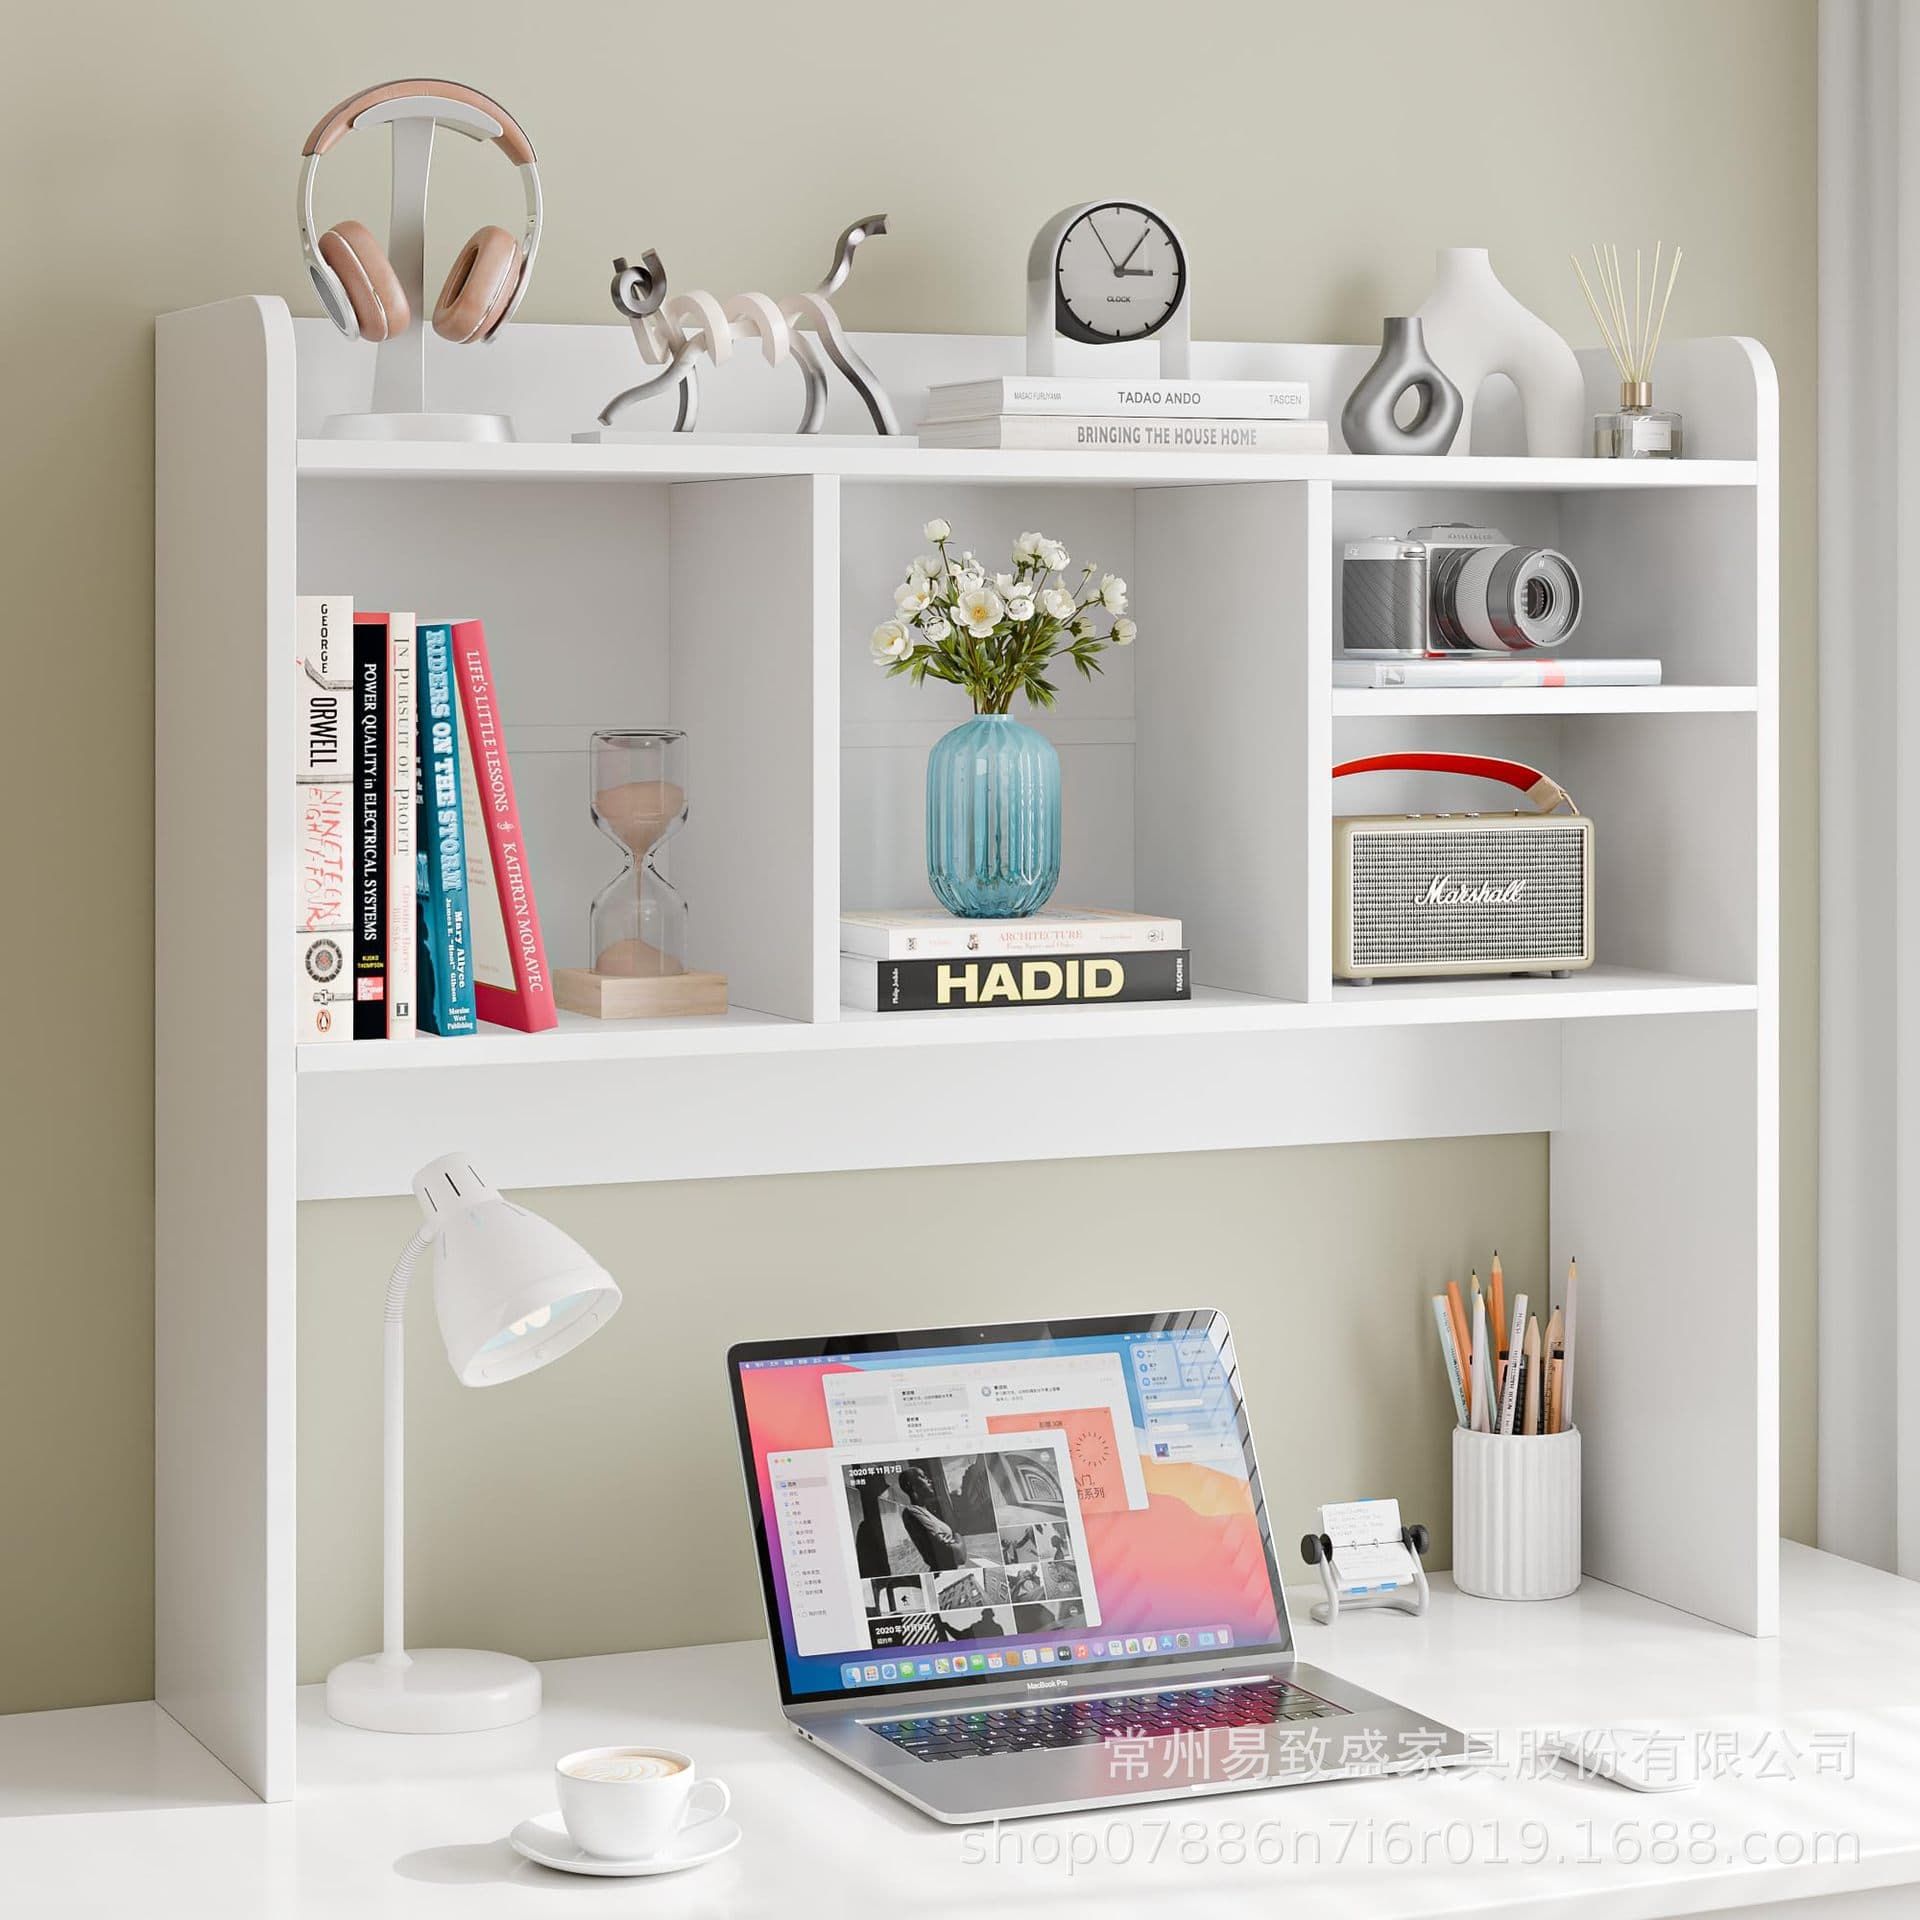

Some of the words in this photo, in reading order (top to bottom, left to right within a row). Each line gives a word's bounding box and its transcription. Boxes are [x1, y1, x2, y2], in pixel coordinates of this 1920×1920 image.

[1117, 391, 1161, 405] TADAO
[1164, 392, 1201, 405] ANDO
[1077, 425, 1142, 445] BRINGING
[1145, 427, 1171, 446] THE
[1173, 427, 1218, 446] HOUSE
[1220, 428, 1257, 447] HOME
[320, 603, 329, 674] GEORGE
[363, 663, 377, 712] POWER
[425, 629, 451, 719] RIDERS
[466, 649, 487, 694] LIFE'S
[309, 697, 338, 768] ORWELL
[393, 668, 410, 748] PURSUIT
[474, 695, 498, 748] LITTLE
[361, 714, 377, 776] QUALITY
[432, 722, 453, 754] ON
[363, 778, 377, 789] in
[434, 757, 457, 808] THE
[485, 748, 509, 813] LESSONS
[363, 793, 377, 877] ELECTRICAL
[393, 789, 410, 857] PROFIT
[320, 788, 344, 924] NINETEEN
[437, 810, 462, 893] STORM
[363, 880, 377, 941] SYSTEMS
[1414, 874, 1527, 906] Marshall
[454, 910, 465, 946] Mary
[503, 841, 529, 916] KATHRYN
[518, 919, 544, 993] MORAVEC
[999, 928, 1084, 942] ARCHITECTURE
[456, 948, 466, 989] Allyce
[936, 957, 1125, 1005] HADID
[1175, 958, 1184, 993] TASCHEN
[848, 1464, 903, 1478] 2020年11月7日
[1026, 1680, 1055, 1690] MacBook
[1056, 1679, 1068, 1687] Pro
